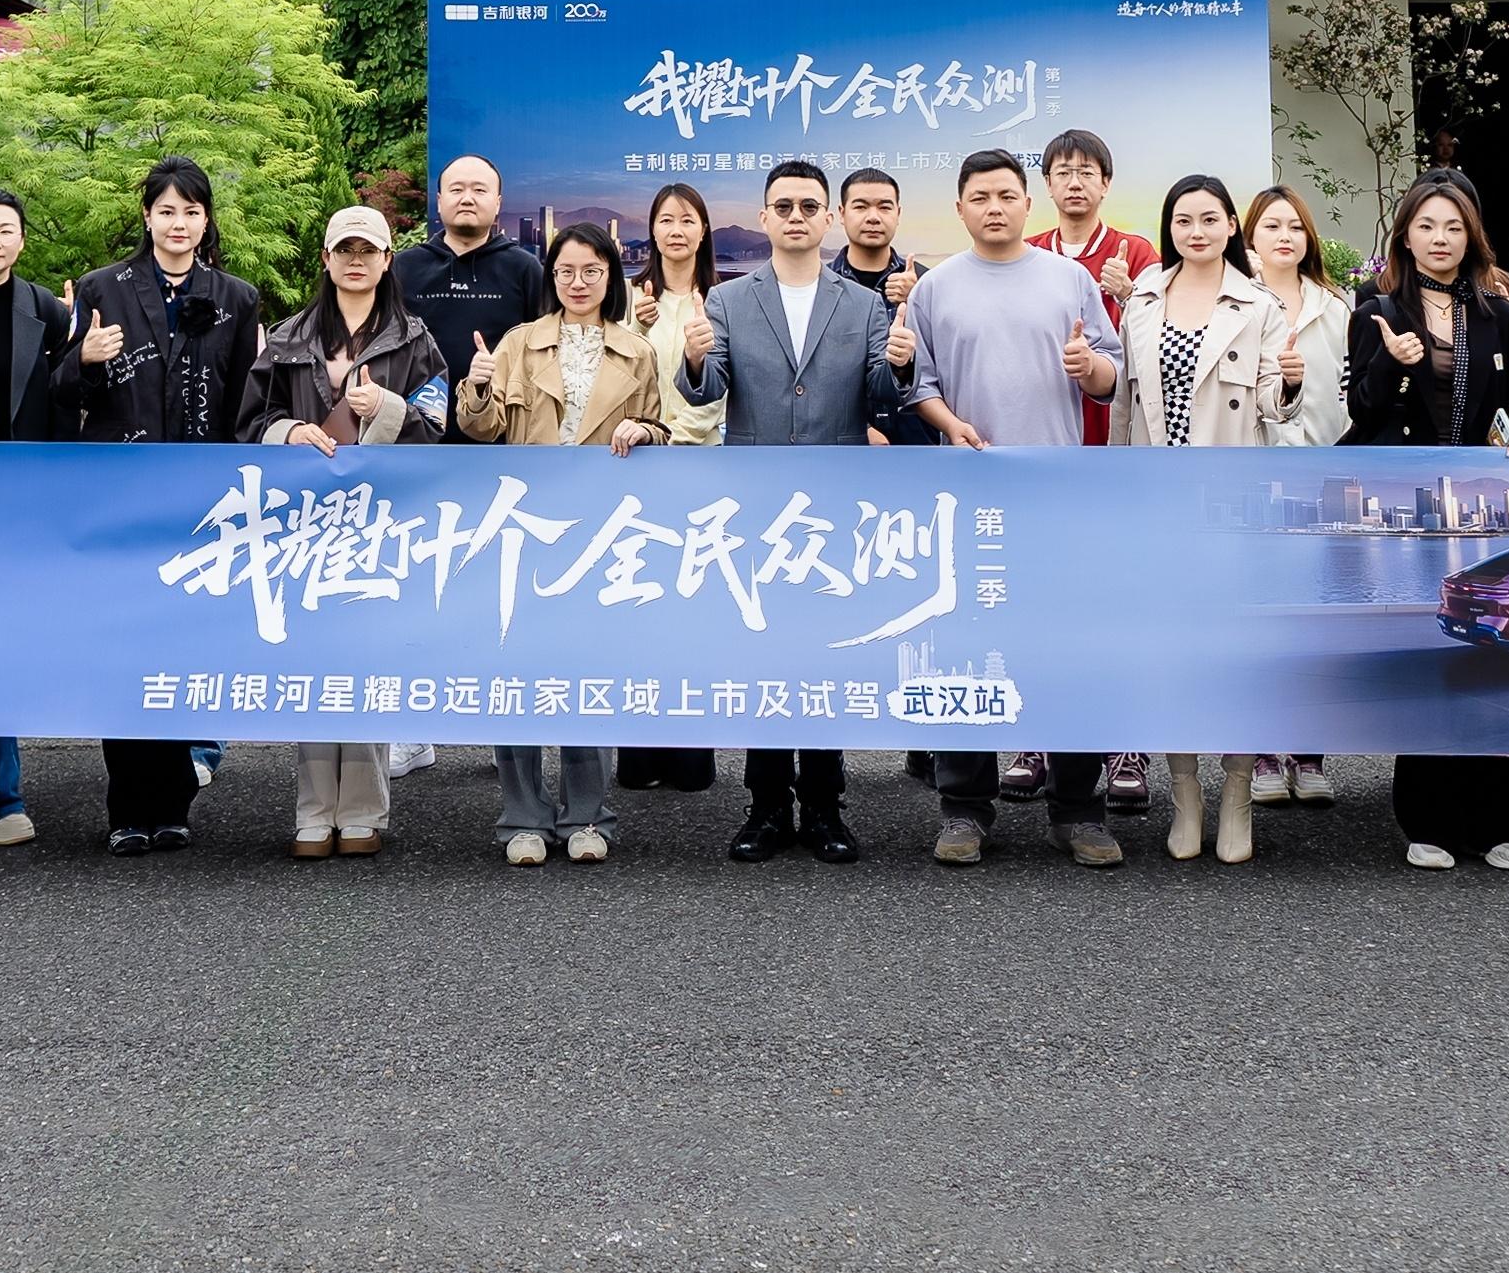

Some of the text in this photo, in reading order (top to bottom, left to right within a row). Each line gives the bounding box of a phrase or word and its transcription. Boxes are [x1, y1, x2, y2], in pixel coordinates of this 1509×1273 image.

[482, 3, 607, 20] 吉利银河 200万
[1117, 0, 1243, 17] 造每个人的智能精品车
[1044, 68, 1061, 117] 第二季
[974, 507, 1008, 609] 第二季
[141, 671, 1008, 721] 吉利银河星耀8远航家区域上市及试驾 武汉站
